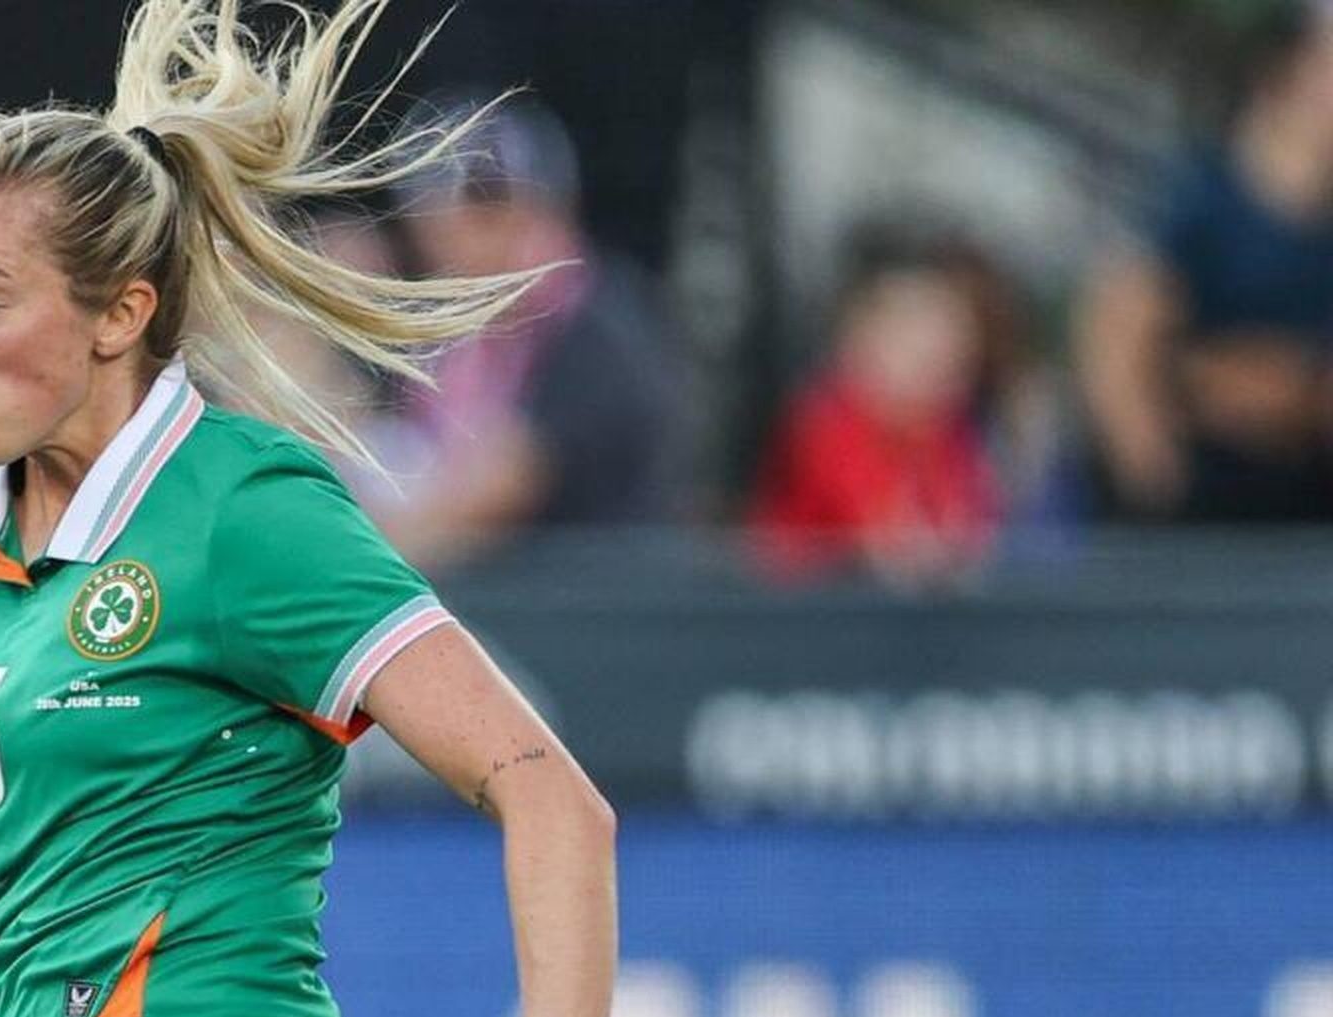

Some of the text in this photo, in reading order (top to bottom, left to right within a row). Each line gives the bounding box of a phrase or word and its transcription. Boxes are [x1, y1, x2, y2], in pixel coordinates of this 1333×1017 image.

[86, 565, 153, 599] IRELAND
[69, 679, 100, 692] USA
[64, 696, 102, 708] JUNE
